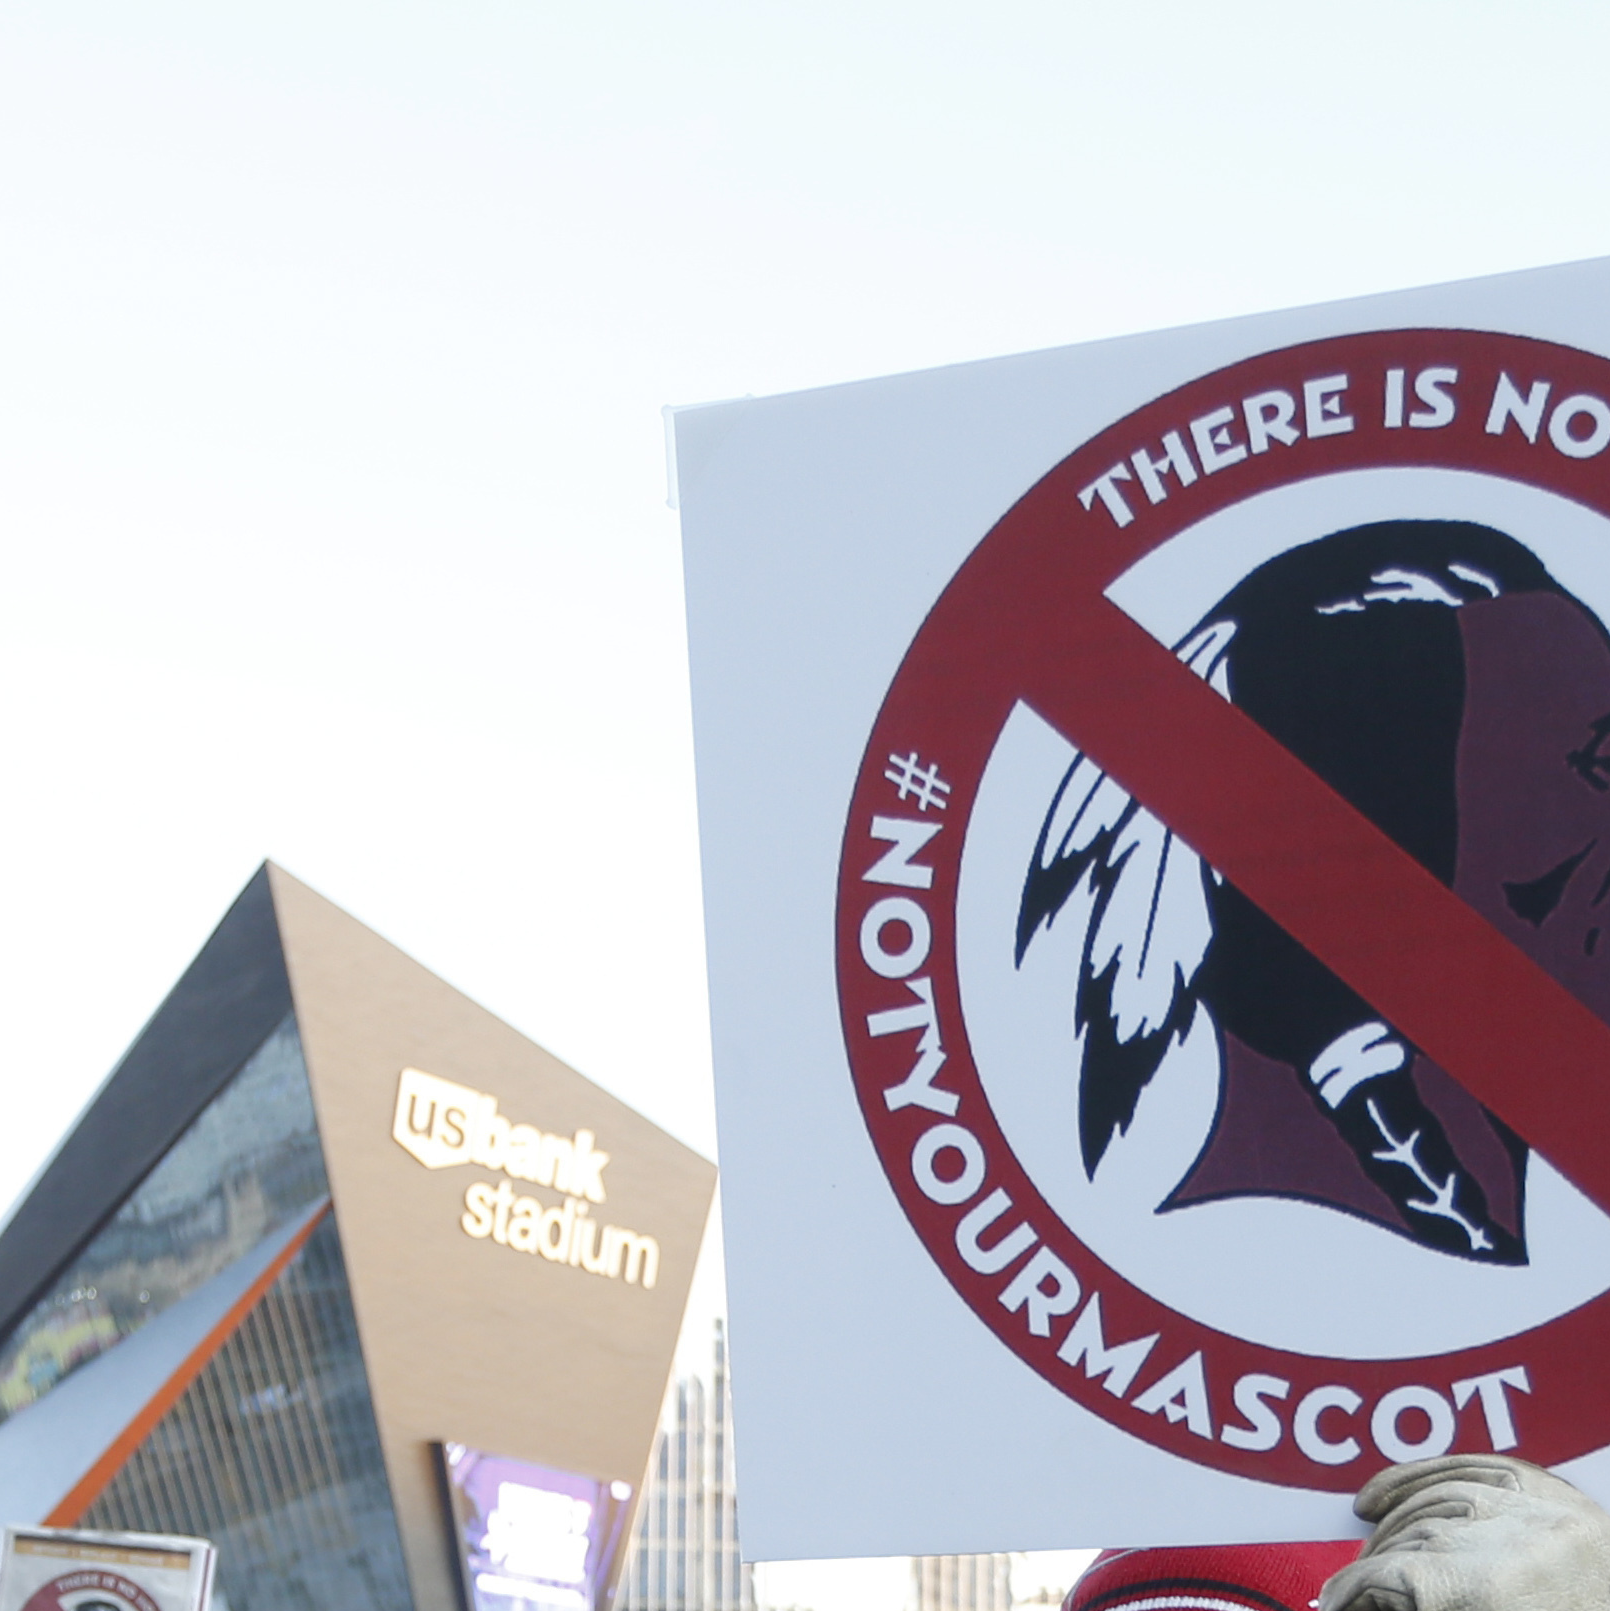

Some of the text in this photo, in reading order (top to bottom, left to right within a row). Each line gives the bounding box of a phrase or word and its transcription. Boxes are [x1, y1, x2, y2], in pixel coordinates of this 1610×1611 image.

[1076, 373, 1355, 528] THERE
[1383, 366, 1459, 429] IS
[859, 751, 1532, 1466] #NOTYOURMASCOT
[461, 1179, 660, 1290] stadium
[55, 1575, 100, 1592] THERE
